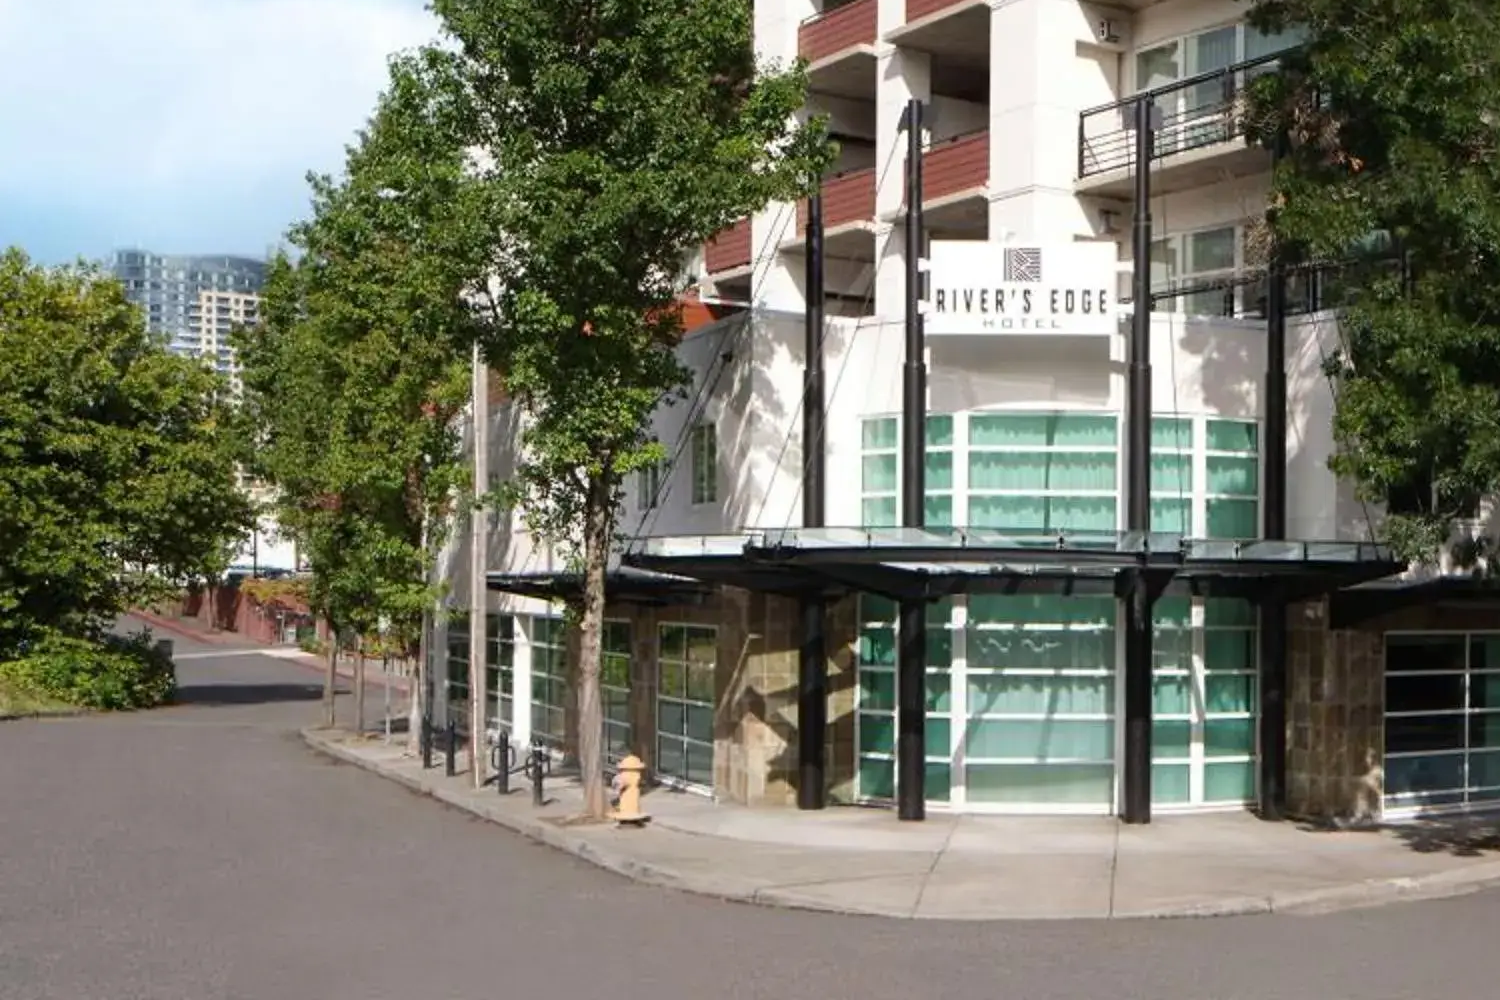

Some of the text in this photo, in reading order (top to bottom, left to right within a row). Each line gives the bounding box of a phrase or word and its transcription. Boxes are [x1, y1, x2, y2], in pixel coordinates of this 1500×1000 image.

[936, 288, 1108, 313] RIVER'S EDGE
[983, 317, 1062, 329] HOTEL
